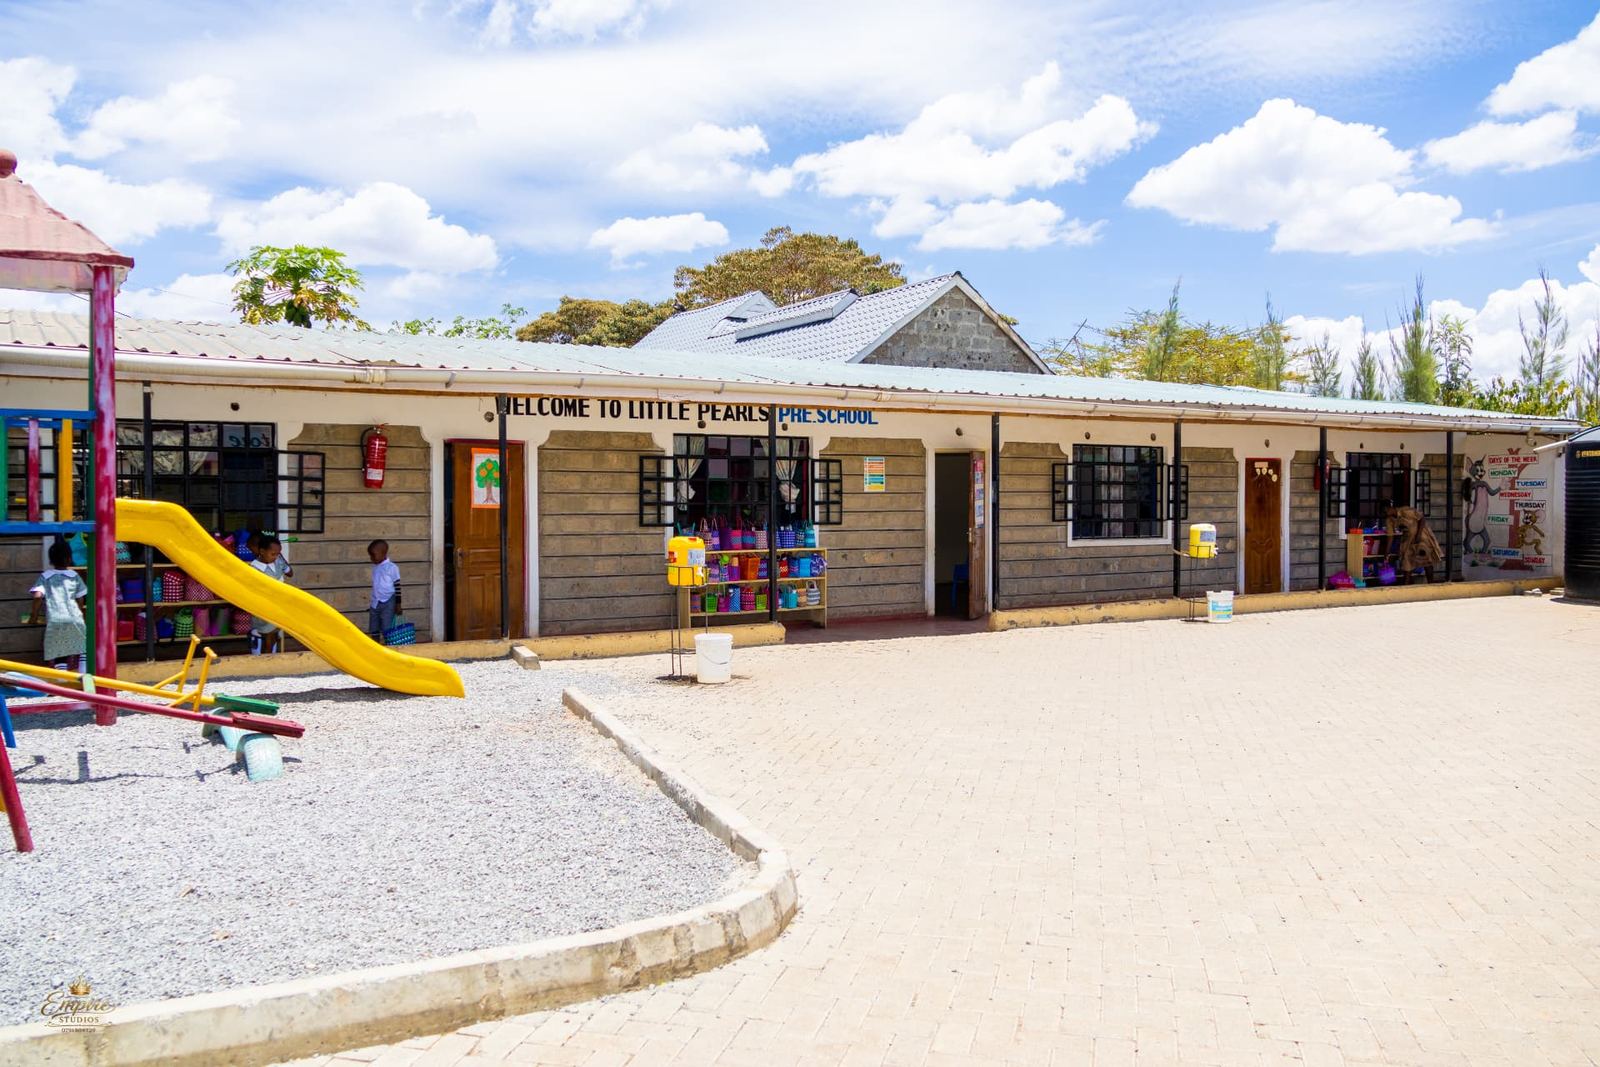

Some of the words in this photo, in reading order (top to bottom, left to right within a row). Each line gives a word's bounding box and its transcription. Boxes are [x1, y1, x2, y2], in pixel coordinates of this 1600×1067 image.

[597, 399, 621, 418] TO
[629, 400, 690, 420] LITTLE
[698, 404, 770, 422] PEARLS
[1490, 469, 1517, 477] MONDAY
